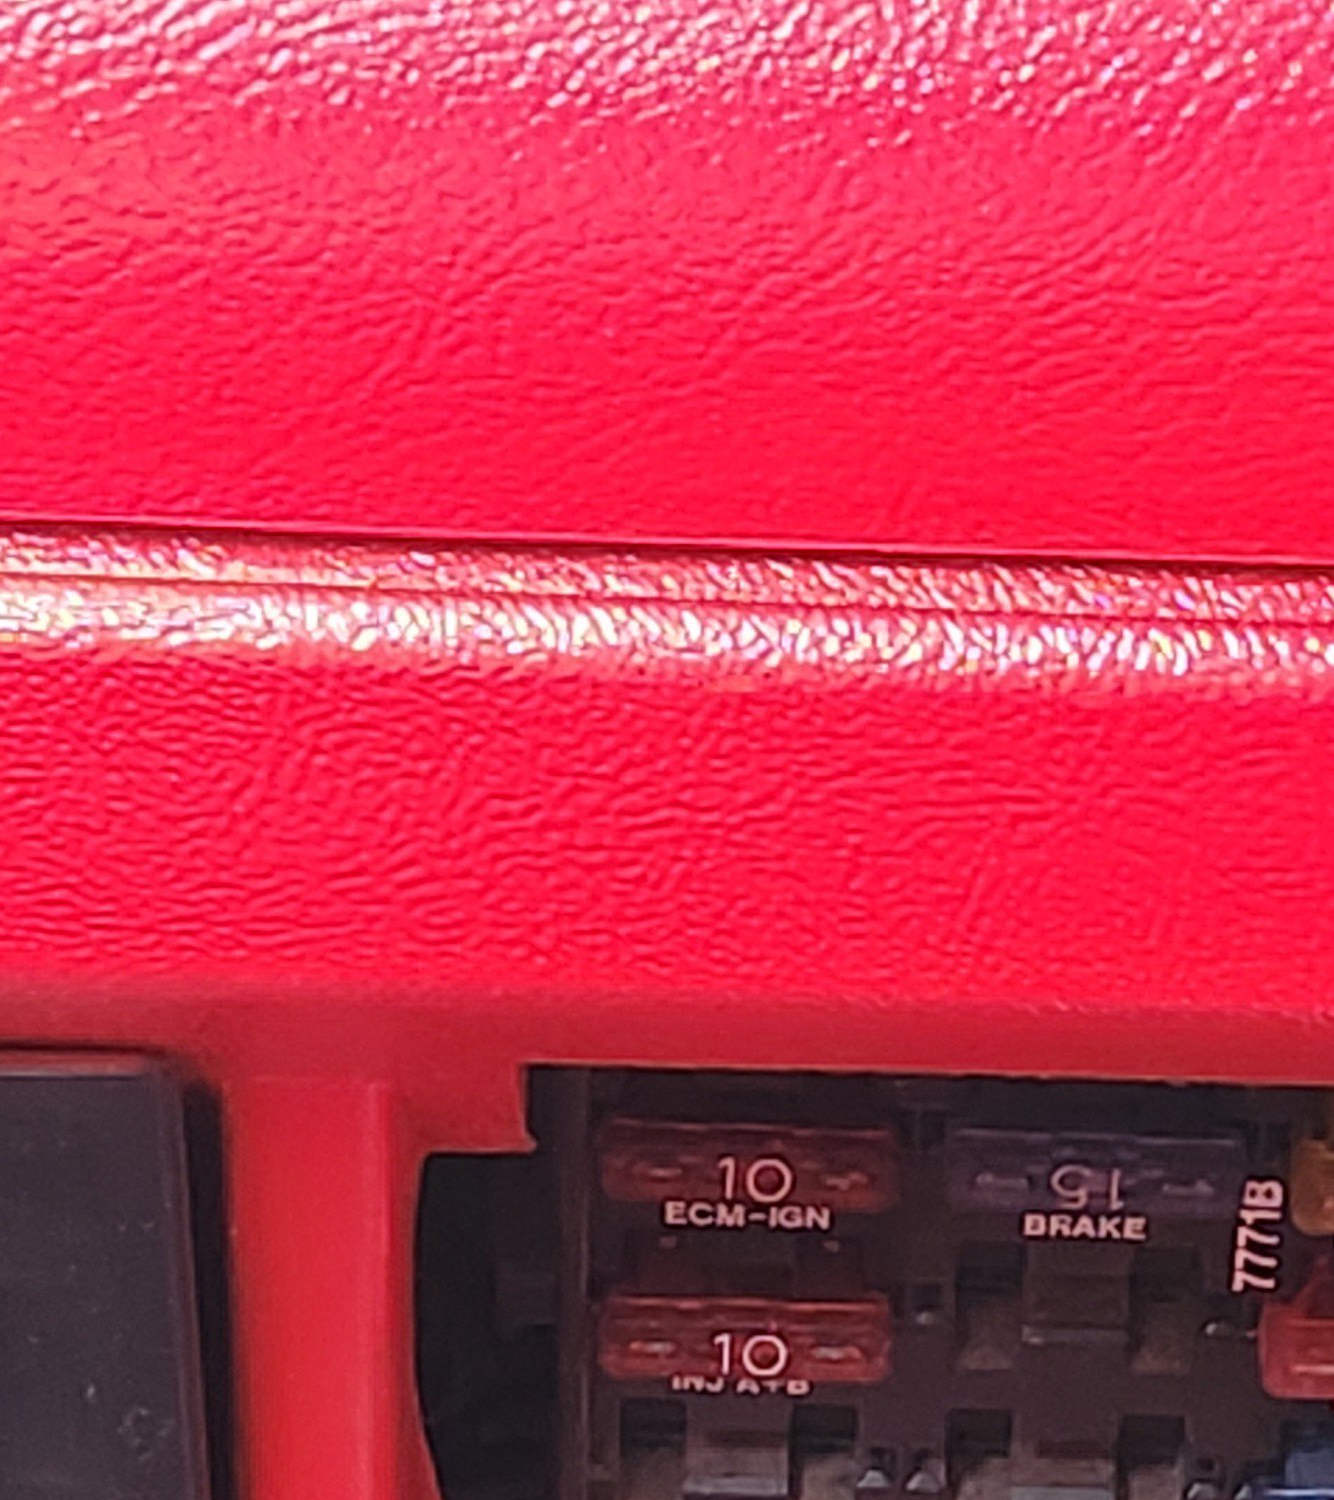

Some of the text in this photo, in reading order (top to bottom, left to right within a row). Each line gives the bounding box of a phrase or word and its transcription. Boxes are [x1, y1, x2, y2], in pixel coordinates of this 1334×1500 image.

[716, 1156, 794, 1202] 10
[663, 1201, 831, 1230] ECM-IGN
[1023, 1212, 1147, 1241] BRAKE
[1230, 1180, 1284, 1293] 7771B
[713, 1332, 789, 1377] 10
